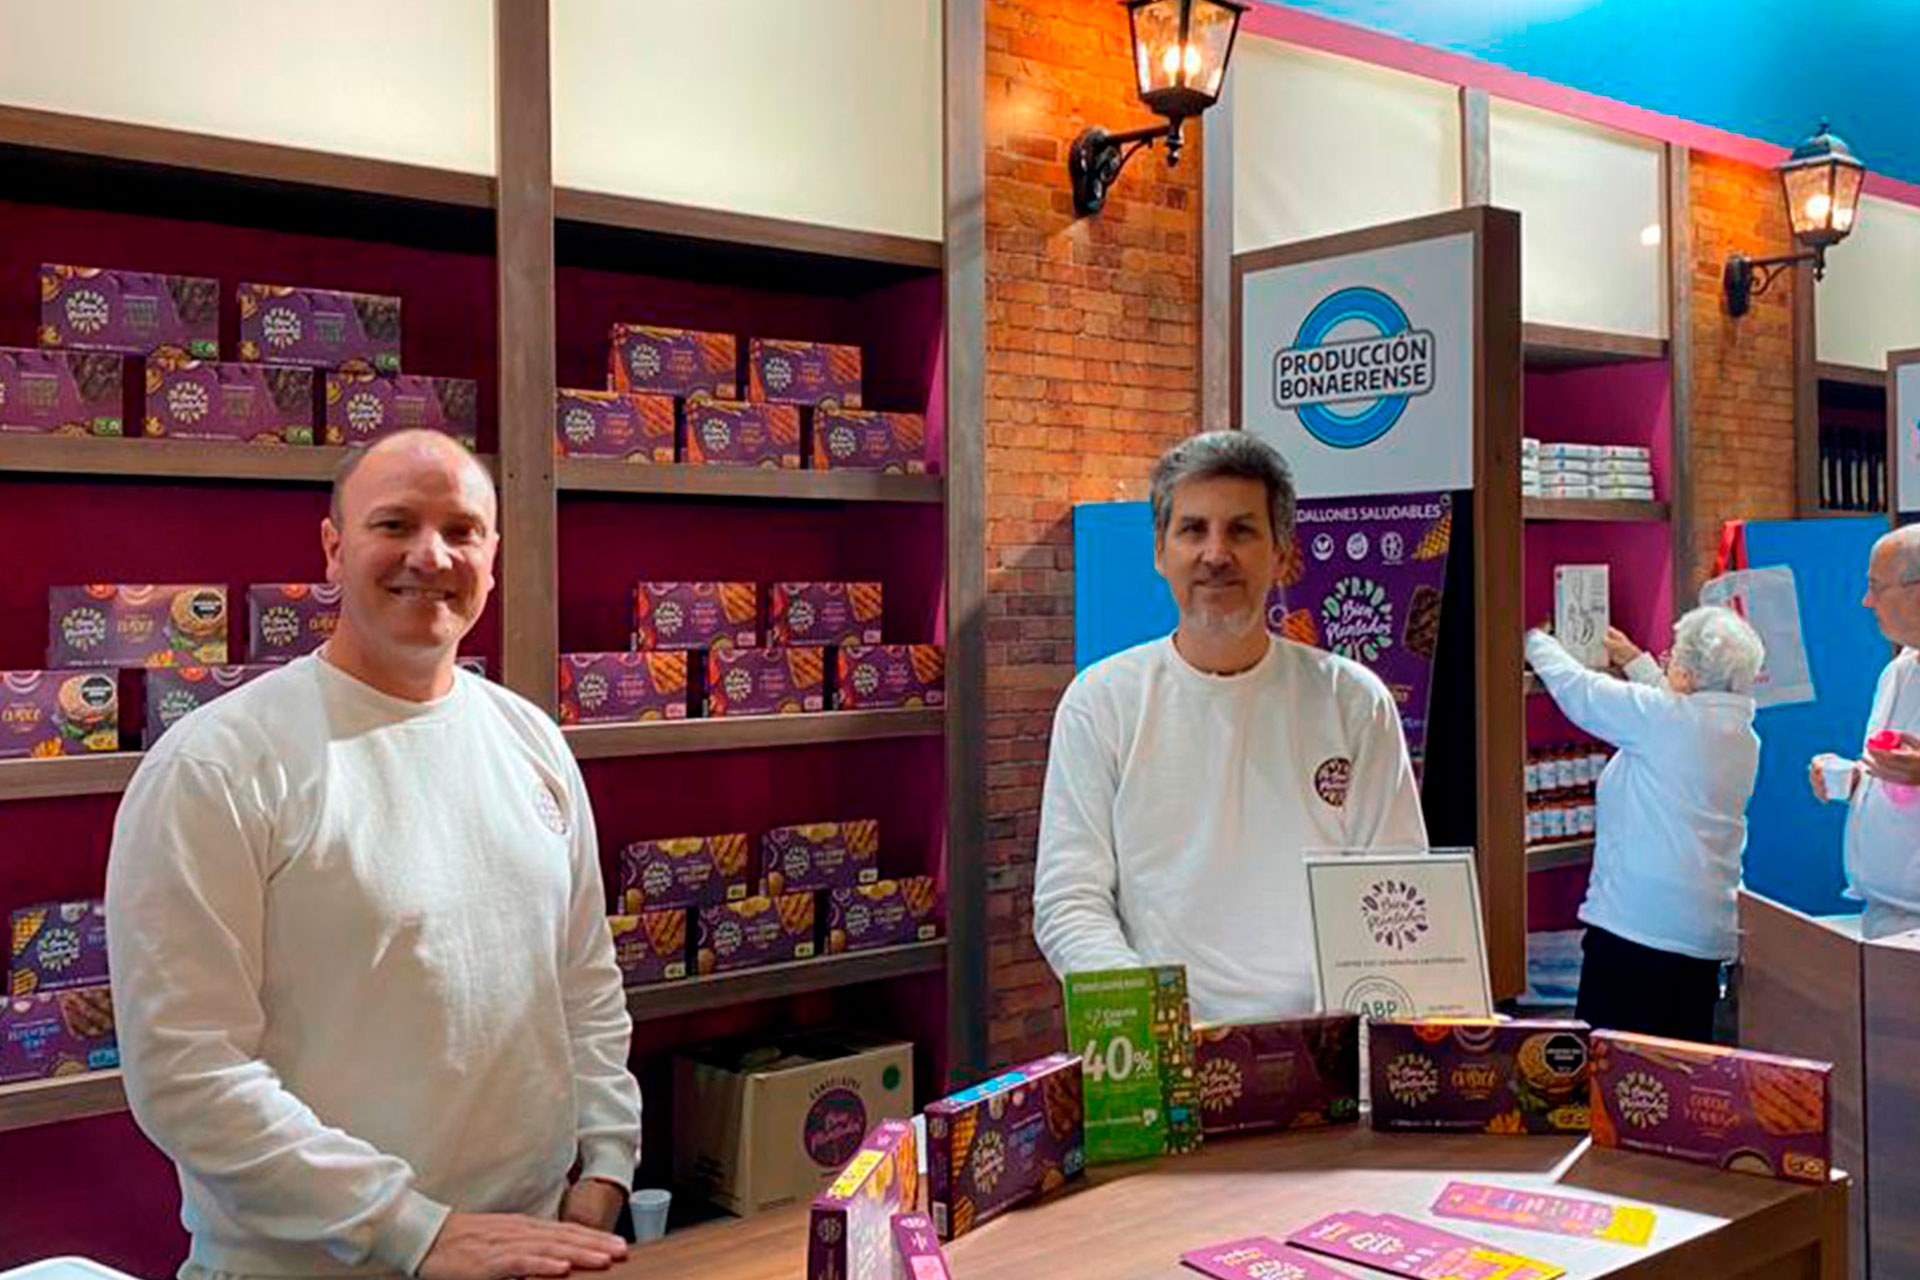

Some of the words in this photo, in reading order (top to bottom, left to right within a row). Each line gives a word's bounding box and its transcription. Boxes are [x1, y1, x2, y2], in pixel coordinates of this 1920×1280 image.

[1280, 334, 1427, 377] PRODUCCIÓN
[1280, 363, 1427, 400] BONAERENSE
[1296, 507, 1358, 523] DALLONES
[1360, 504, 1442, 521] SALUDABLES
[1342, 599, 1374, 624] Bien
[1326, 615, 1391, 646] Plantados
[1380, 897, 1410, 913] Bien
[1360, 1000, 1398, 1018] ABP
[1083, 1035, 1153, 1082] 40%
